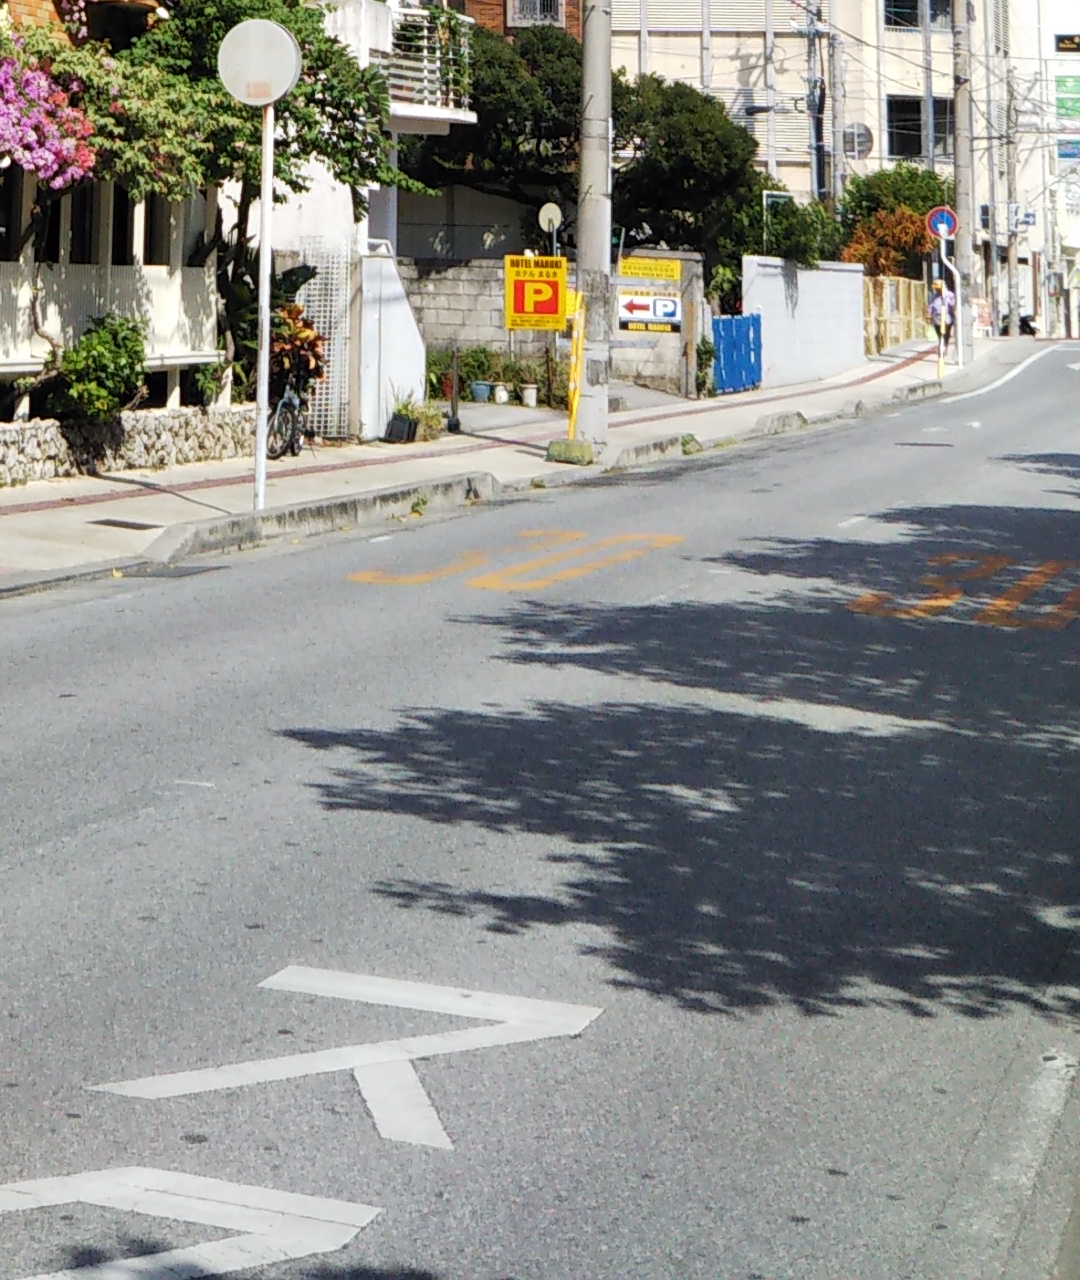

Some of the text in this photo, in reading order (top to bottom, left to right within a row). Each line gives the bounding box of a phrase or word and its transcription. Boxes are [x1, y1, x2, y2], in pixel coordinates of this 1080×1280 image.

[510, 259, 562, 269] HOTEL MARUKI
[515, 270, 535, 278] ホテル
[524, 282, 553, 313] P
